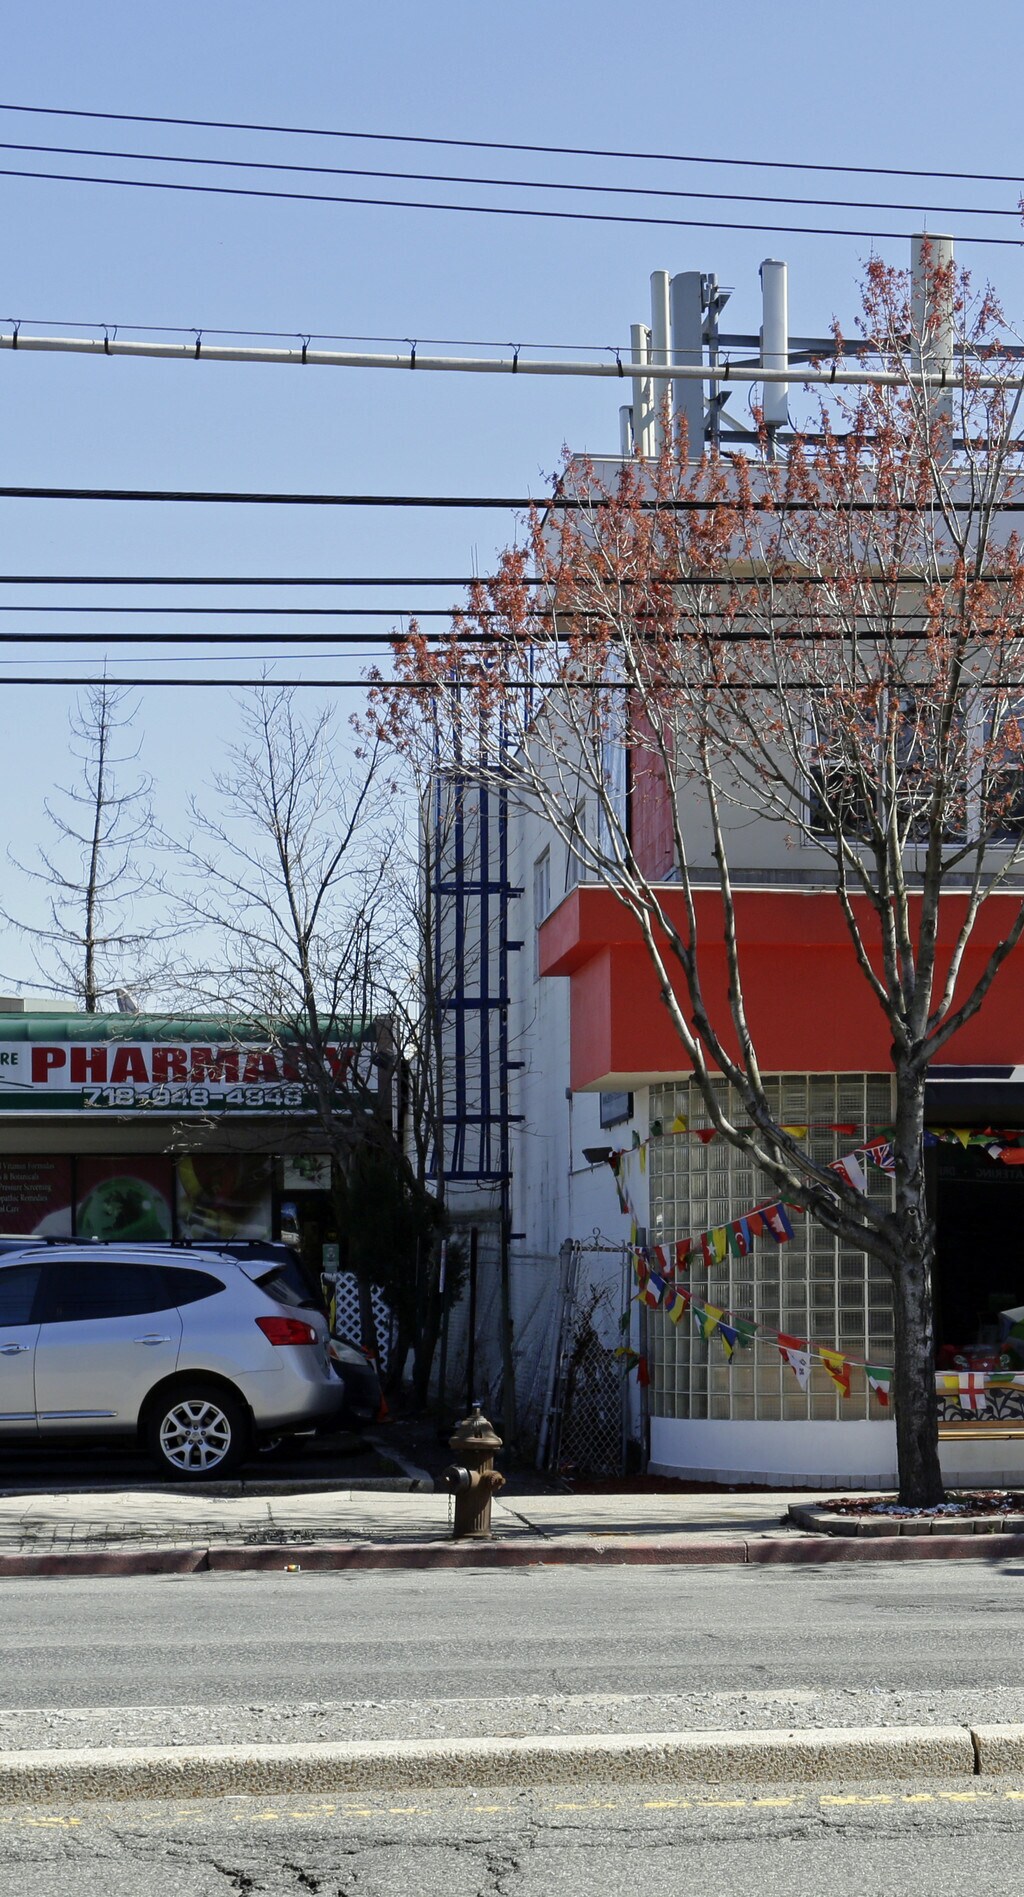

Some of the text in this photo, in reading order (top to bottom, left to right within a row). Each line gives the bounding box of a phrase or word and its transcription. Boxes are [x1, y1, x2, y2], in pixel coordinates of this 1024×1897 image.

[0, 1052, 18, 1066] RE
[82, 1086, 303, 1107] 718-948-4848
[24, 1184, 52, 1193] Screening
